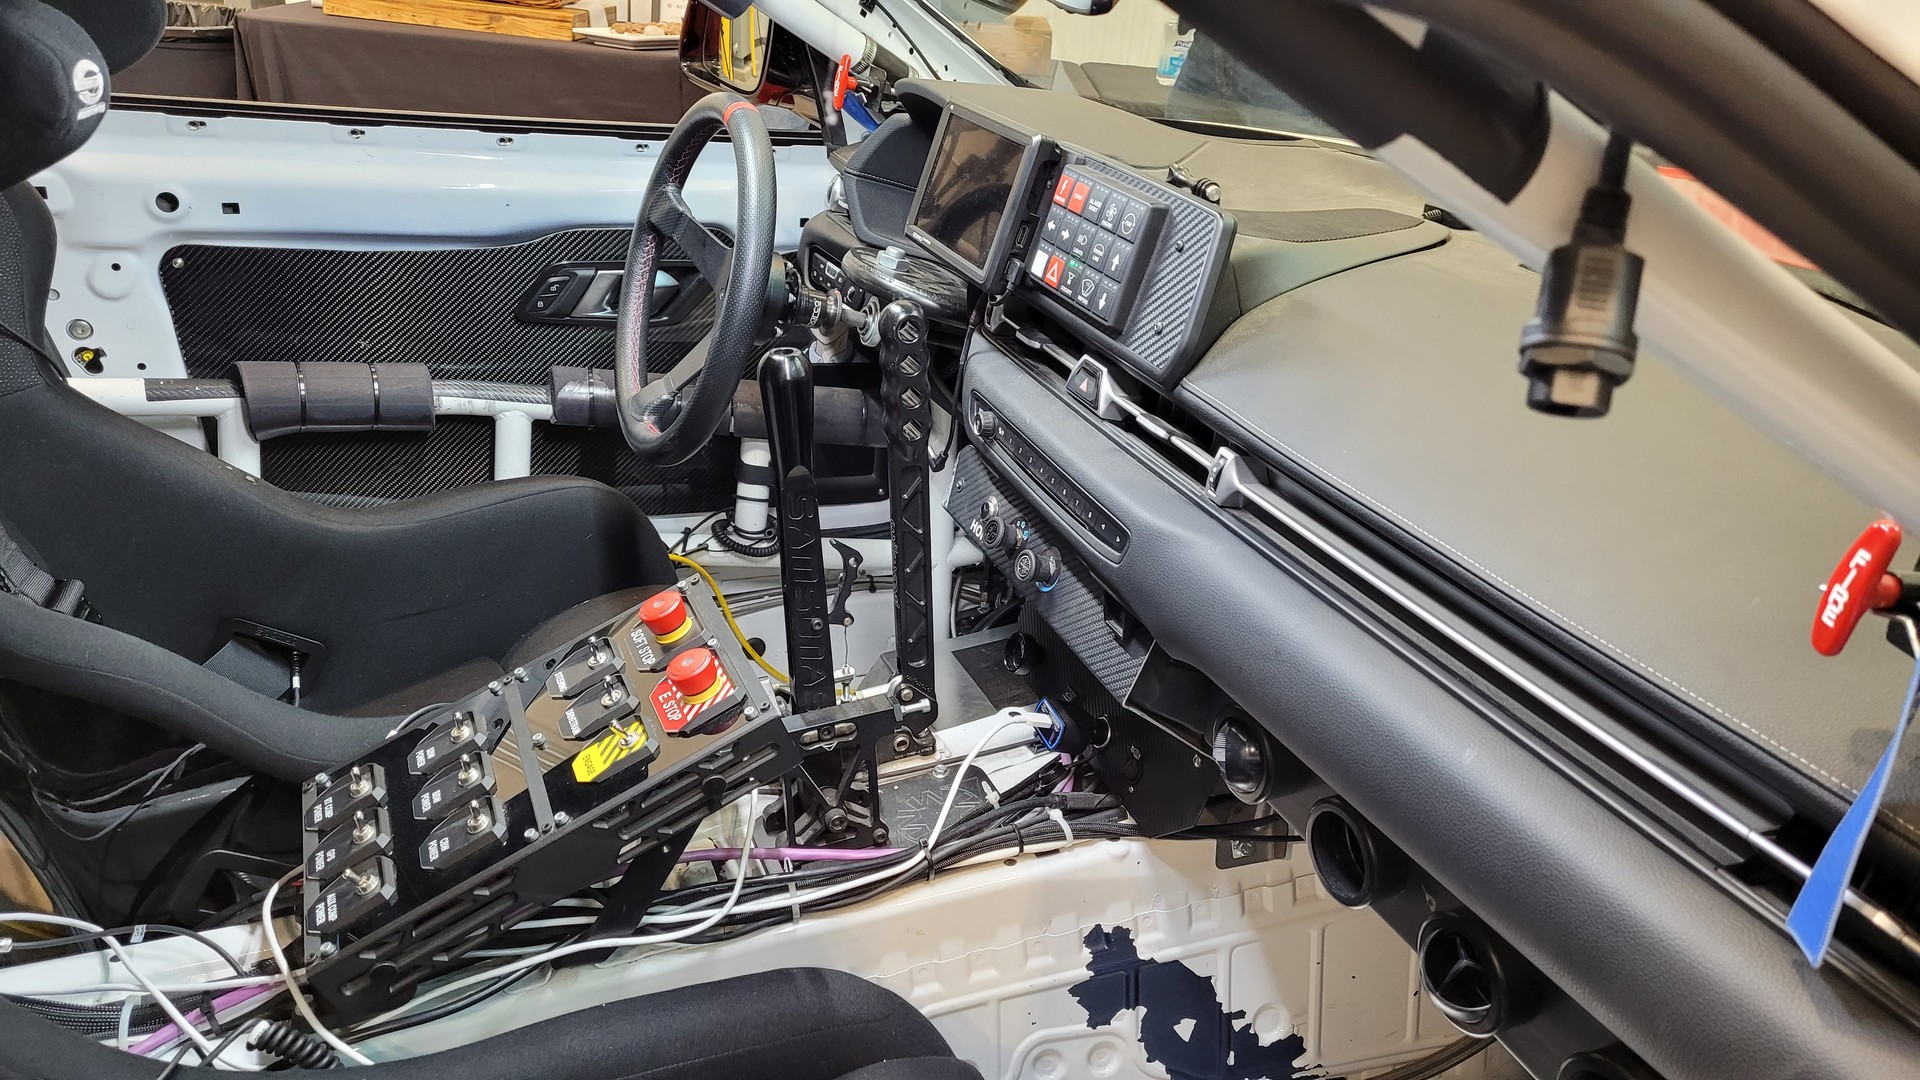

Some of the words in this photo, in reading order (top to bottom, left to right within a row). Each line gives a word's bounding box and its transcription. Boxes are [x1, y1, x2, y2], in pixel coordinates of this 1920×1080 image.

[834, 65, 844, 97] FIRE
[1089, 198, 1102, 208] ALARM
[1821, 547, 1872, 629] FIRE
[630, 628, 648, 650] SOFT
[638, 645, 656, 666] STOP
[554, 671, 568, 693] STEERING
[565, 708, 581, 736] DRIVETRAIN
[663, 702, 683, 722] STOP
[415, 749, 426, 768] POWER
[582, 754, 596, 776] ENGAGE
[313, 803, 323, 824] POWER
[421, 792, 431, 813] POWER
[315, 850, 324, 872] POWER
[326, 848, 336, 862] GPS
[428, 839, 439, 862] POWER
[326, 892, 337, 905] AUX
[315, 902, 326, 926] POWER
